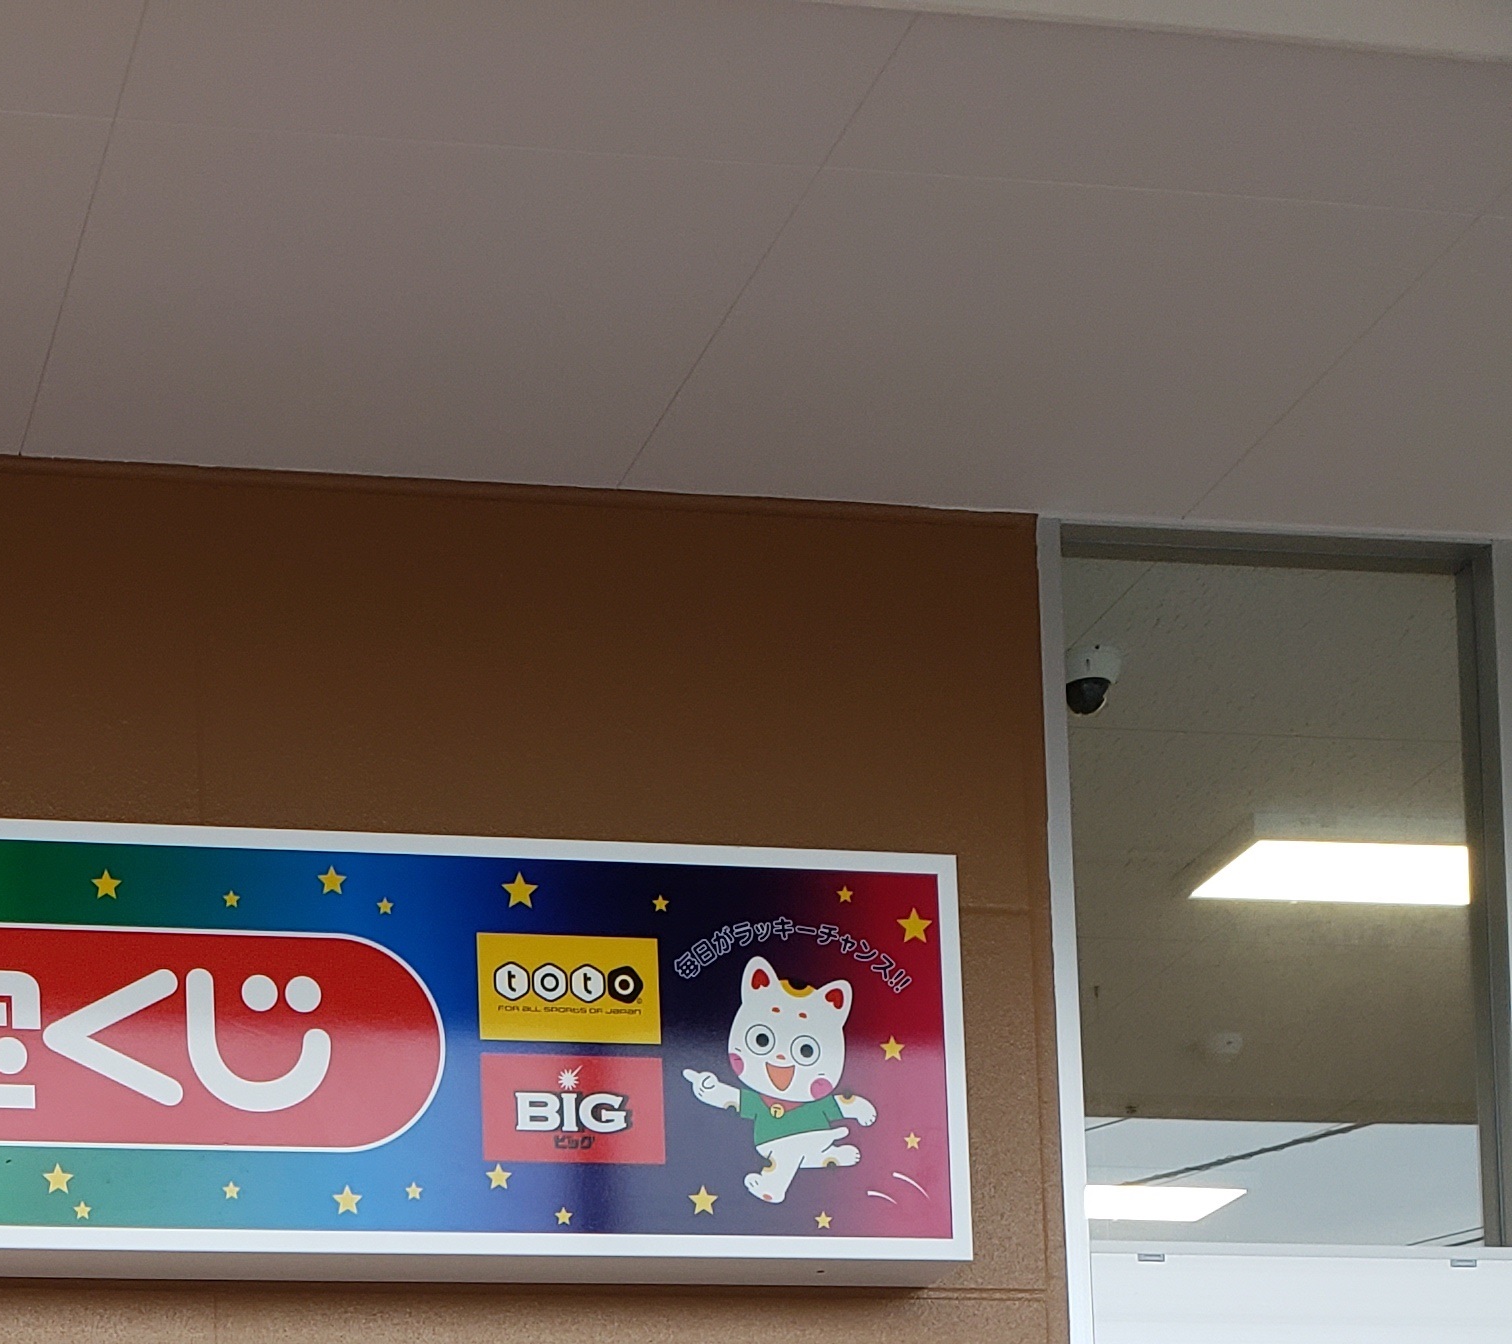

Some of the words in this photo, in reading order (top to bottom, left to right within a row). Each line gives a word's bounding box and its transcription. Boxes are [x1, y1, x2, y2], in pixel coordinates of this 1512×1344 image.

[494, 961, 644, 1004] toto
[514, 1089, 630, 1134] BIG
[554, 1135, 595, 1149] ビッグ
